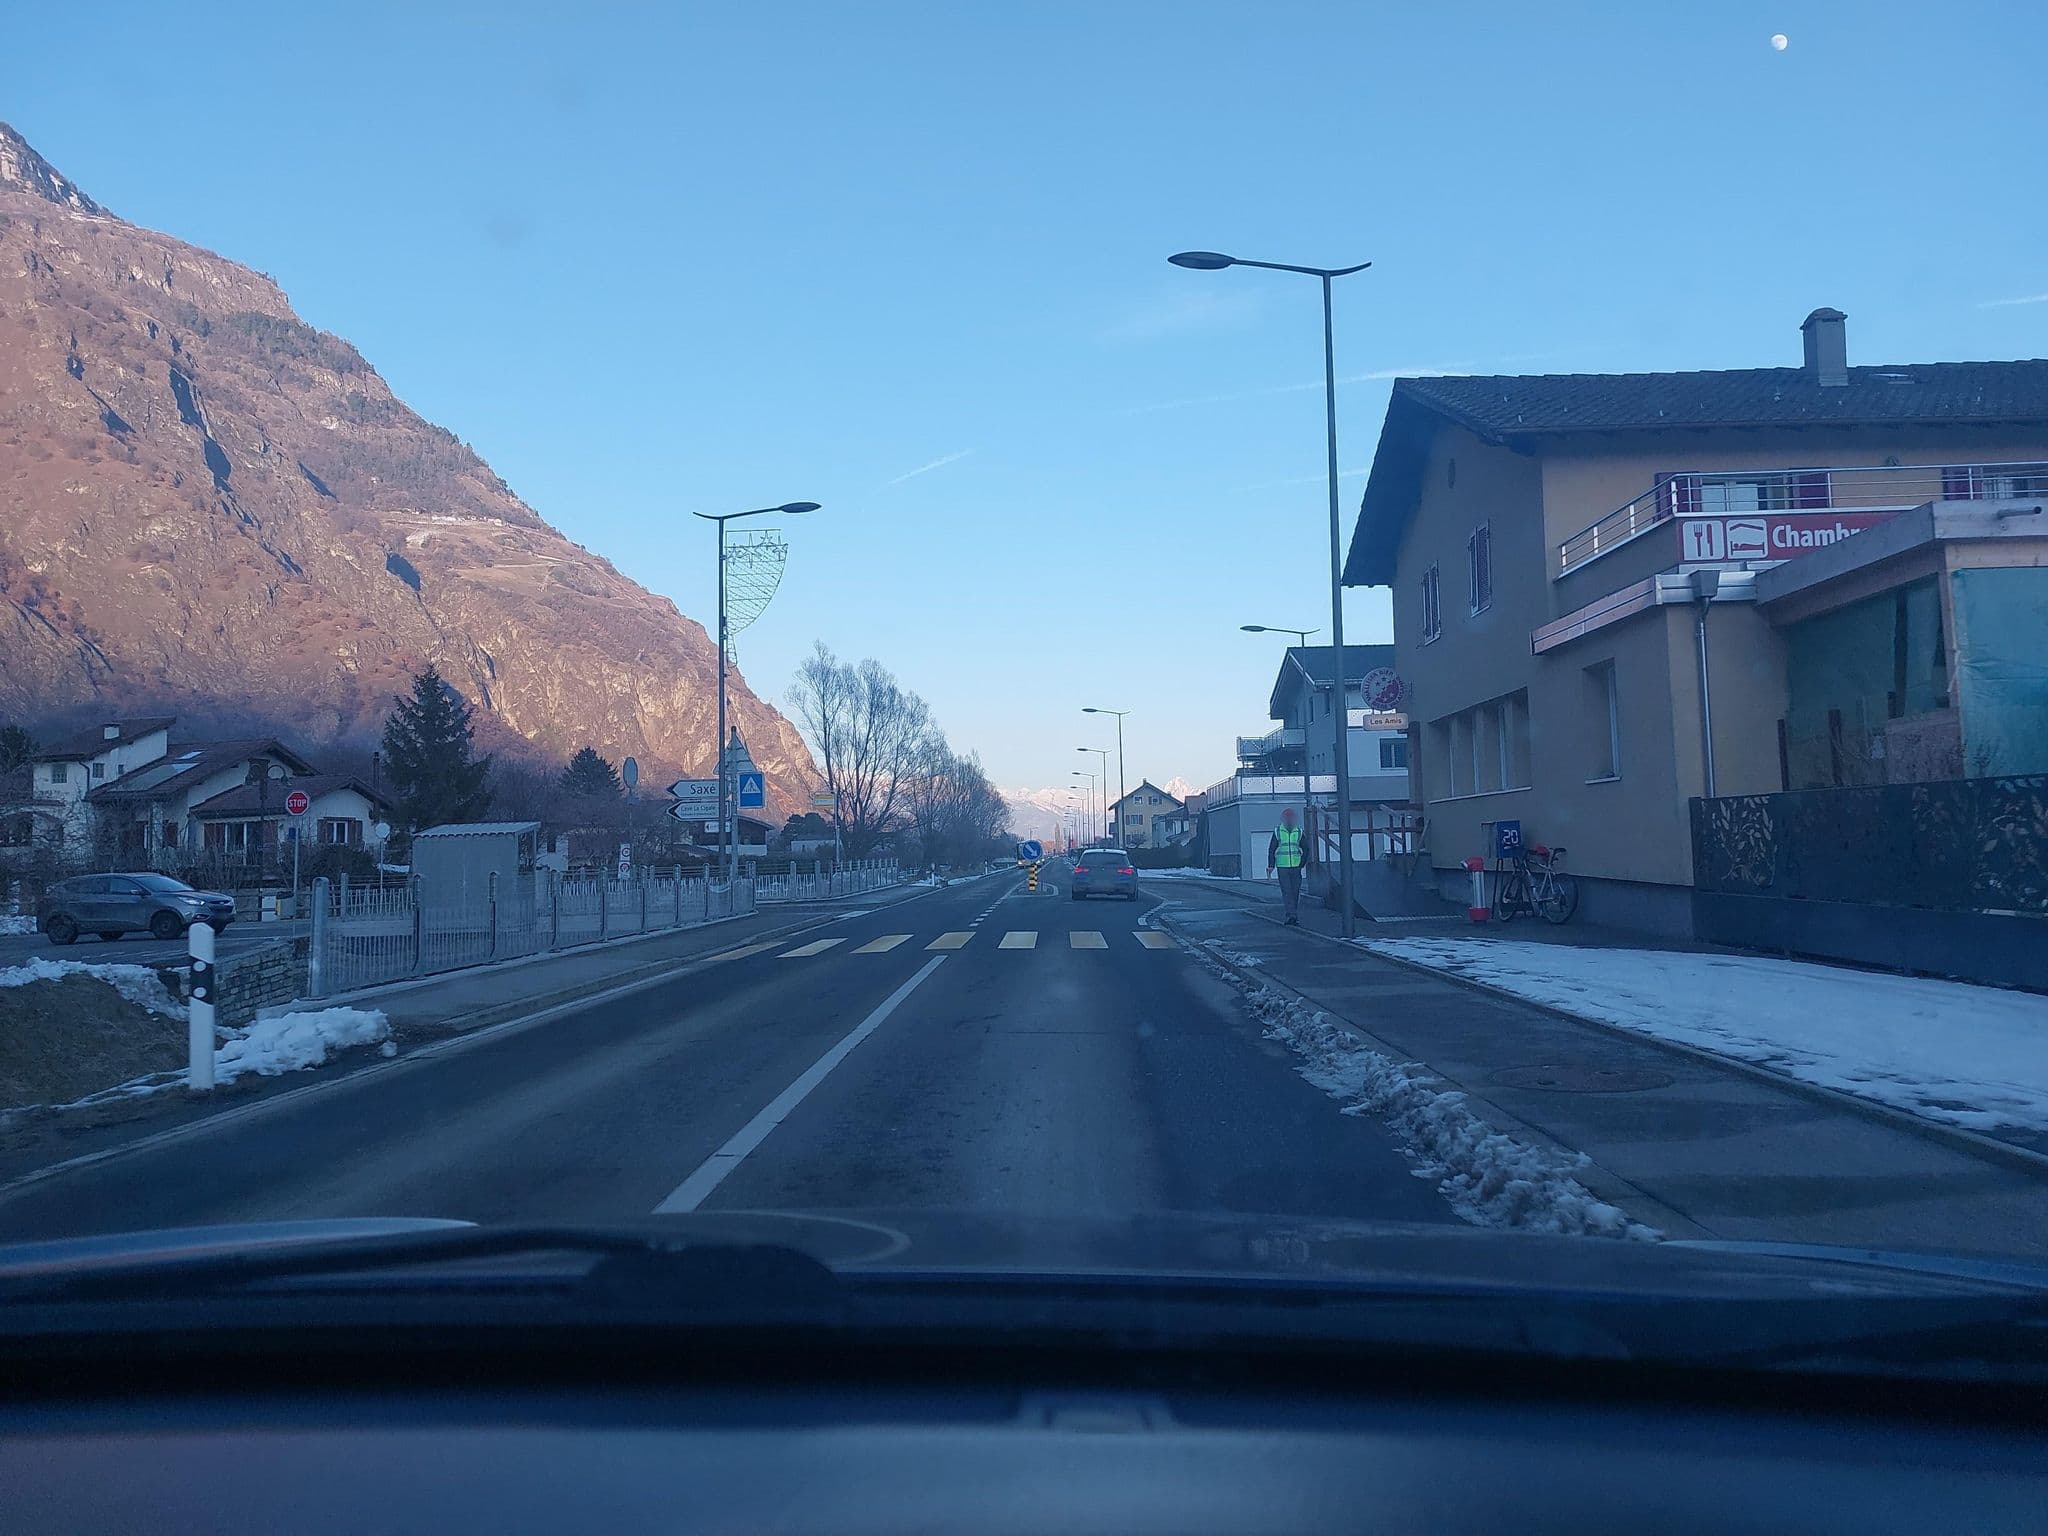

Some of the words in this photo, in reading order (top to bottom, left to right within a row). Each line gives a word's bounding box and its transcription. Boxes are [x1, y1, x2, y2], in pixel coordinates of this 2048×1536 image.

[1772, 522, 1868, 548] Chamb
[690, 783, 716, 795] Saxé
[289, 799, 307, 808] STOP
[1502, 829, 1519, 845] 20
